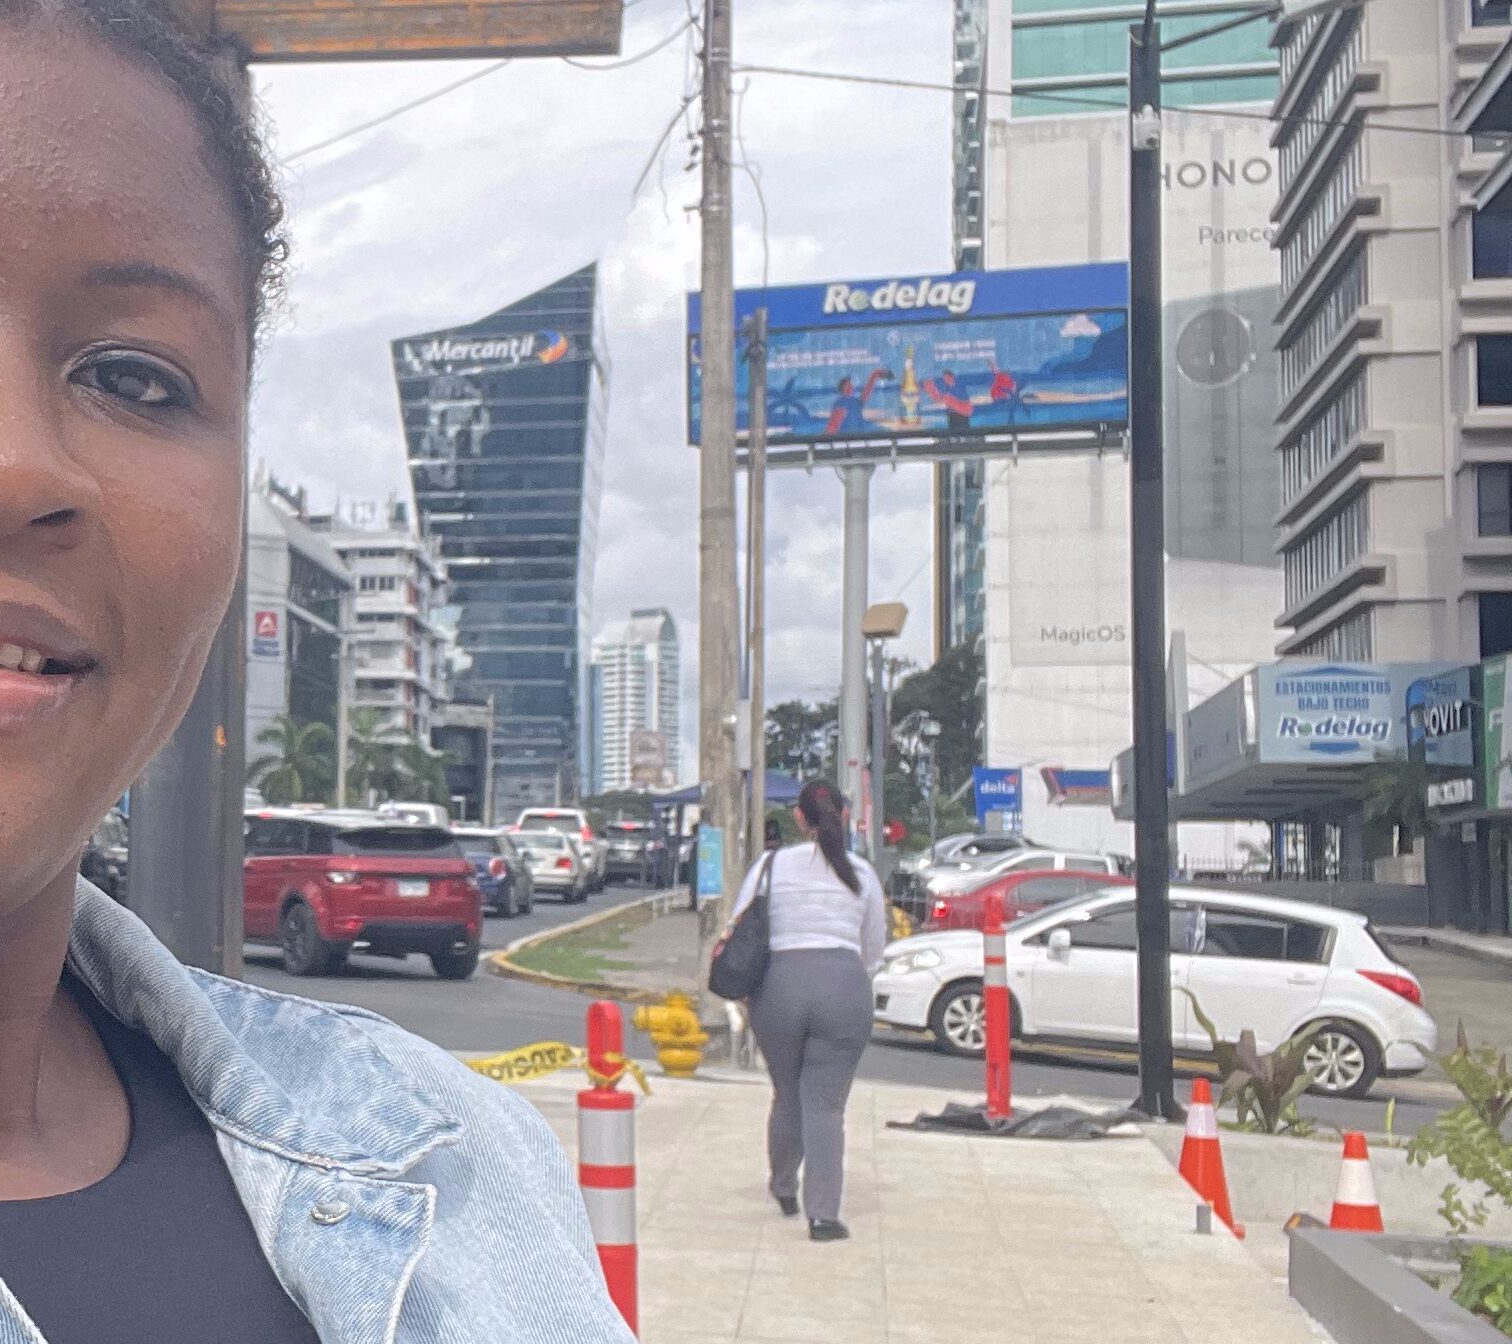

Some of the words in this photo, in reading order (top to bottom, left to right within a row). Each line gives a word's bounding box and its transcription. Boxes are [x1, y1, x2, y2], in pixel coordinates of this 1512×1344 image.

[429, 334, 535, 362] Mercantil
[1040, 624, 1126, 646] MagicOS
[980, 779, 1016, 794] delta
